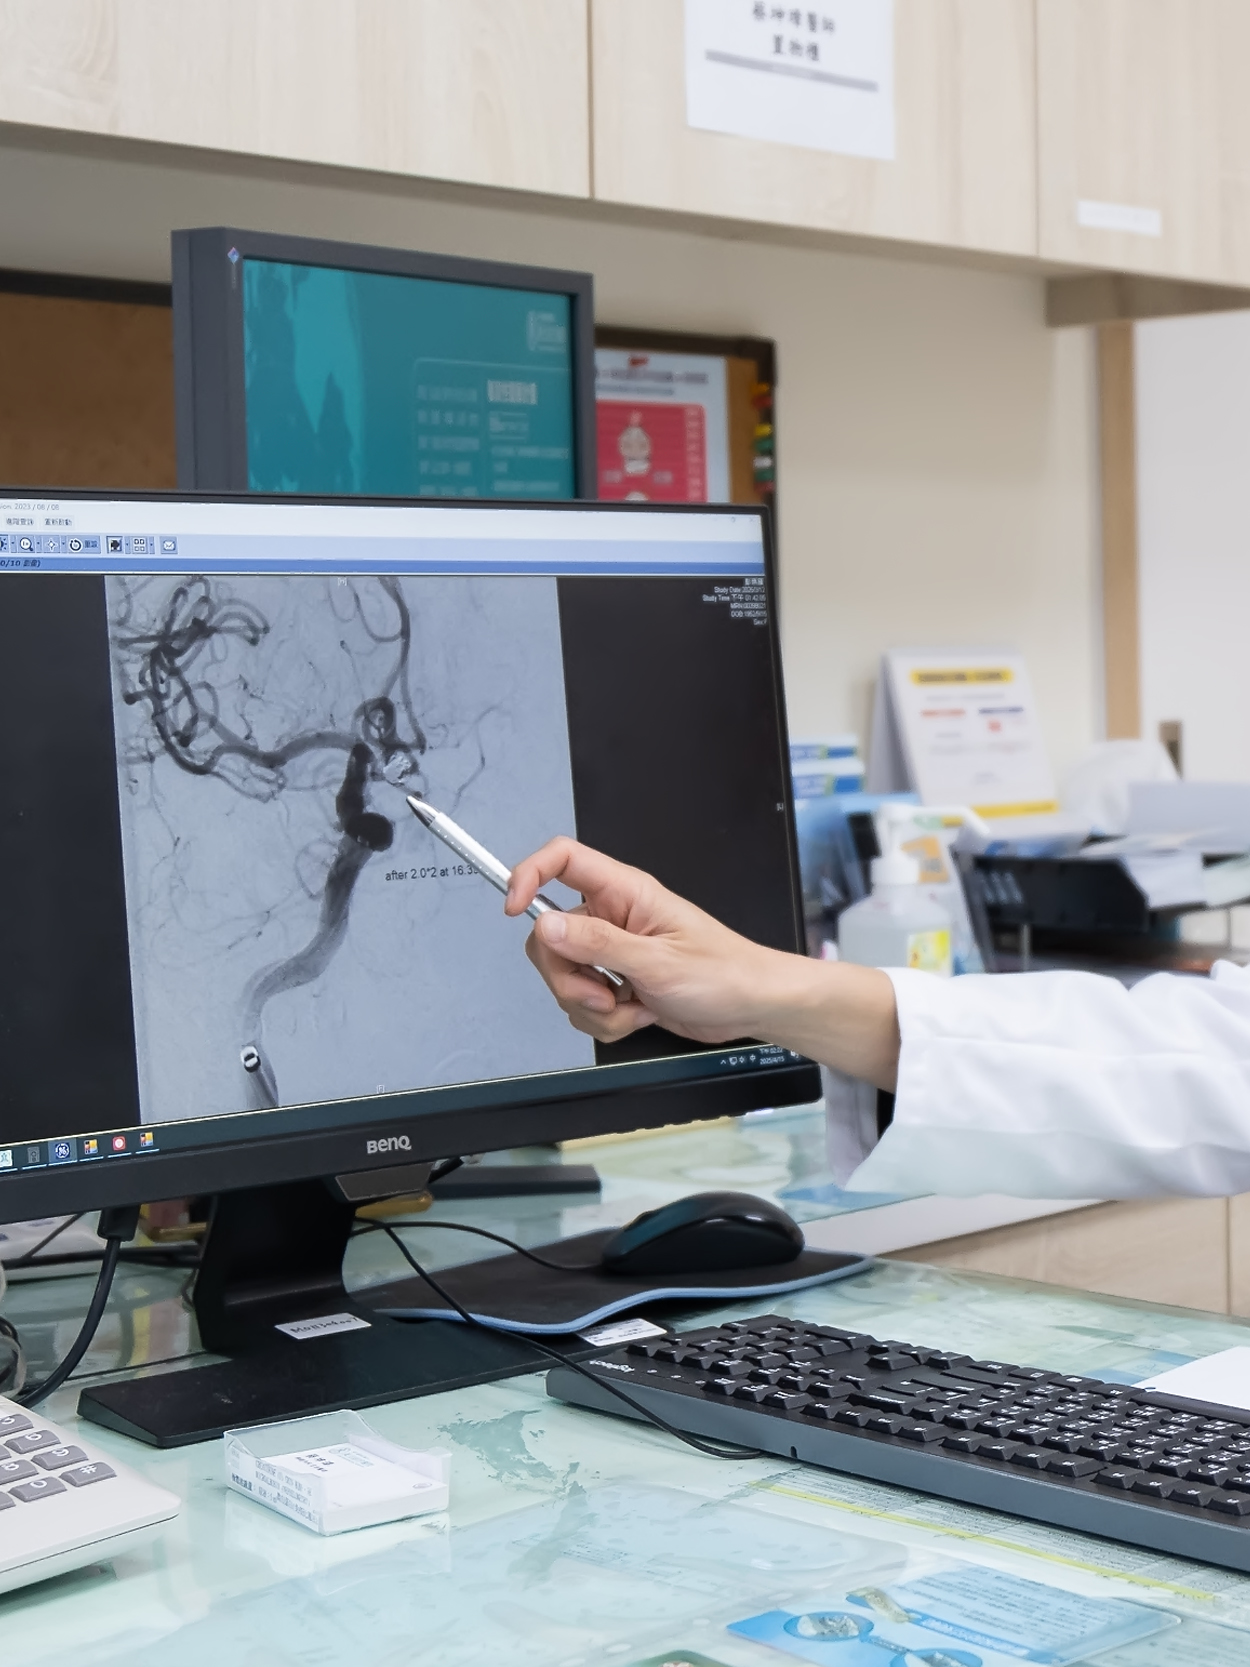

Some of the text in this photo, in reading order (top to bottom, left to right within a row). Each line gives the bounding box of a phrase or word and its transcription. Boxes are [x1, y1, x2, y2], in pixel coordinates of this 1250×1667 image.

[385, 870, 408, 882] after
[439, 867, 449, 878] at
[366, 1135, 412, 1154] BenQ
